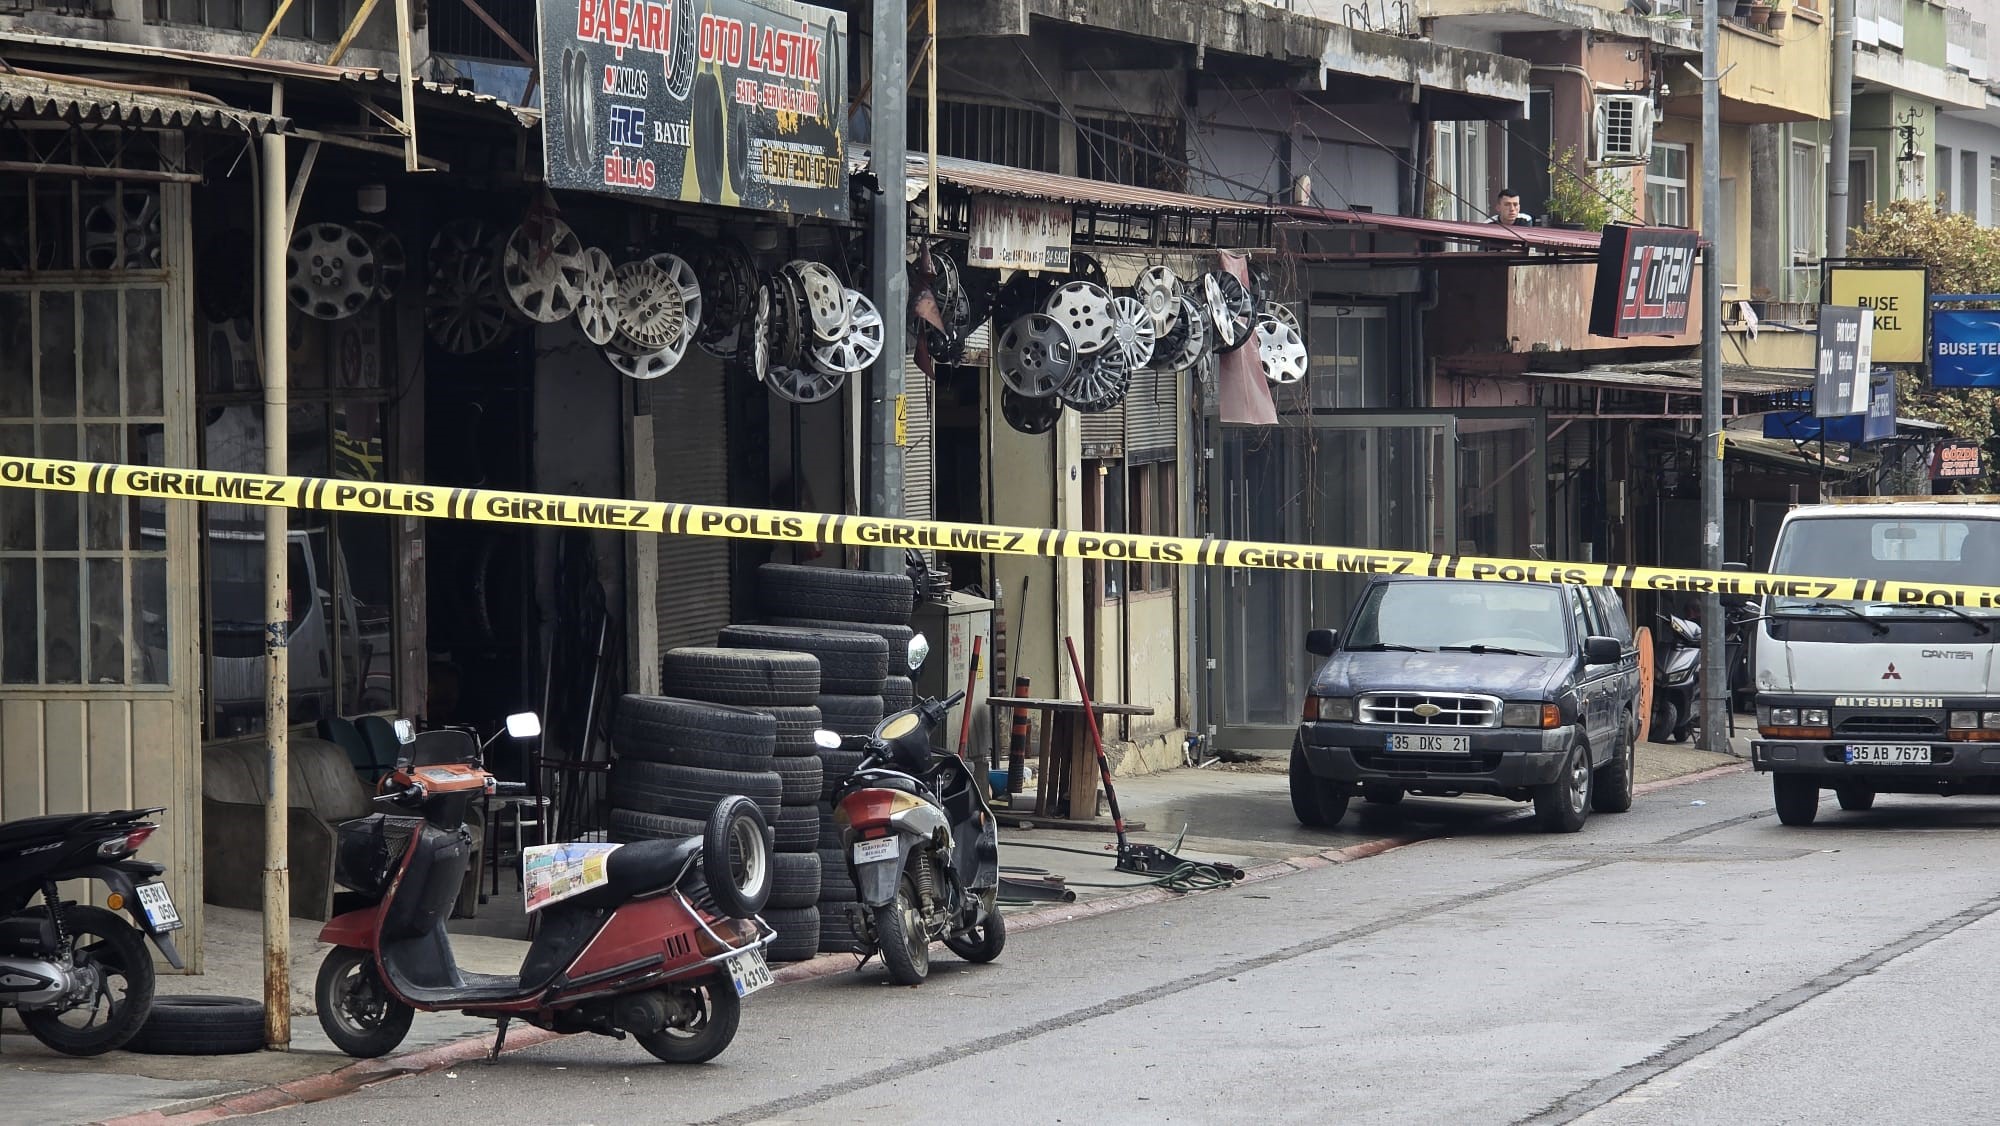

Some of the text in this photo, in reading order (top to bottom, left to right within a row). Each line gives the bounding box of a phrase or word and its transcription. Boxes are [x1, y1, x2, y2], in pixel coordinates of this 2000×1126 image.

[577, 0, 673, 60] BAŞARİ
[699, 13, 822, 82] OTO LASTİK
[615, 66, 648, 100] ANLAS
[604, 146, 656, 190] BİLLAS
[1858, 296, 1899, 311] BUSE
[1938, 342, 2000, 356] BUSE TE
[1, 461, 76, 485] OLİS
[1921, 649, 1973, 660] CANTER
[1834, 697, 1943, 708] MITSUBISHI
[1395, 735, 1467, 751] 35 DKS 21
[1852, 745, 1928, 761] 35 AB 7673
[140, 888, 153, 904] 35
[158, 903, 176, 920] 050
[728, 956, 744, 974] 35
[744, 966, 768, 988] 4318
